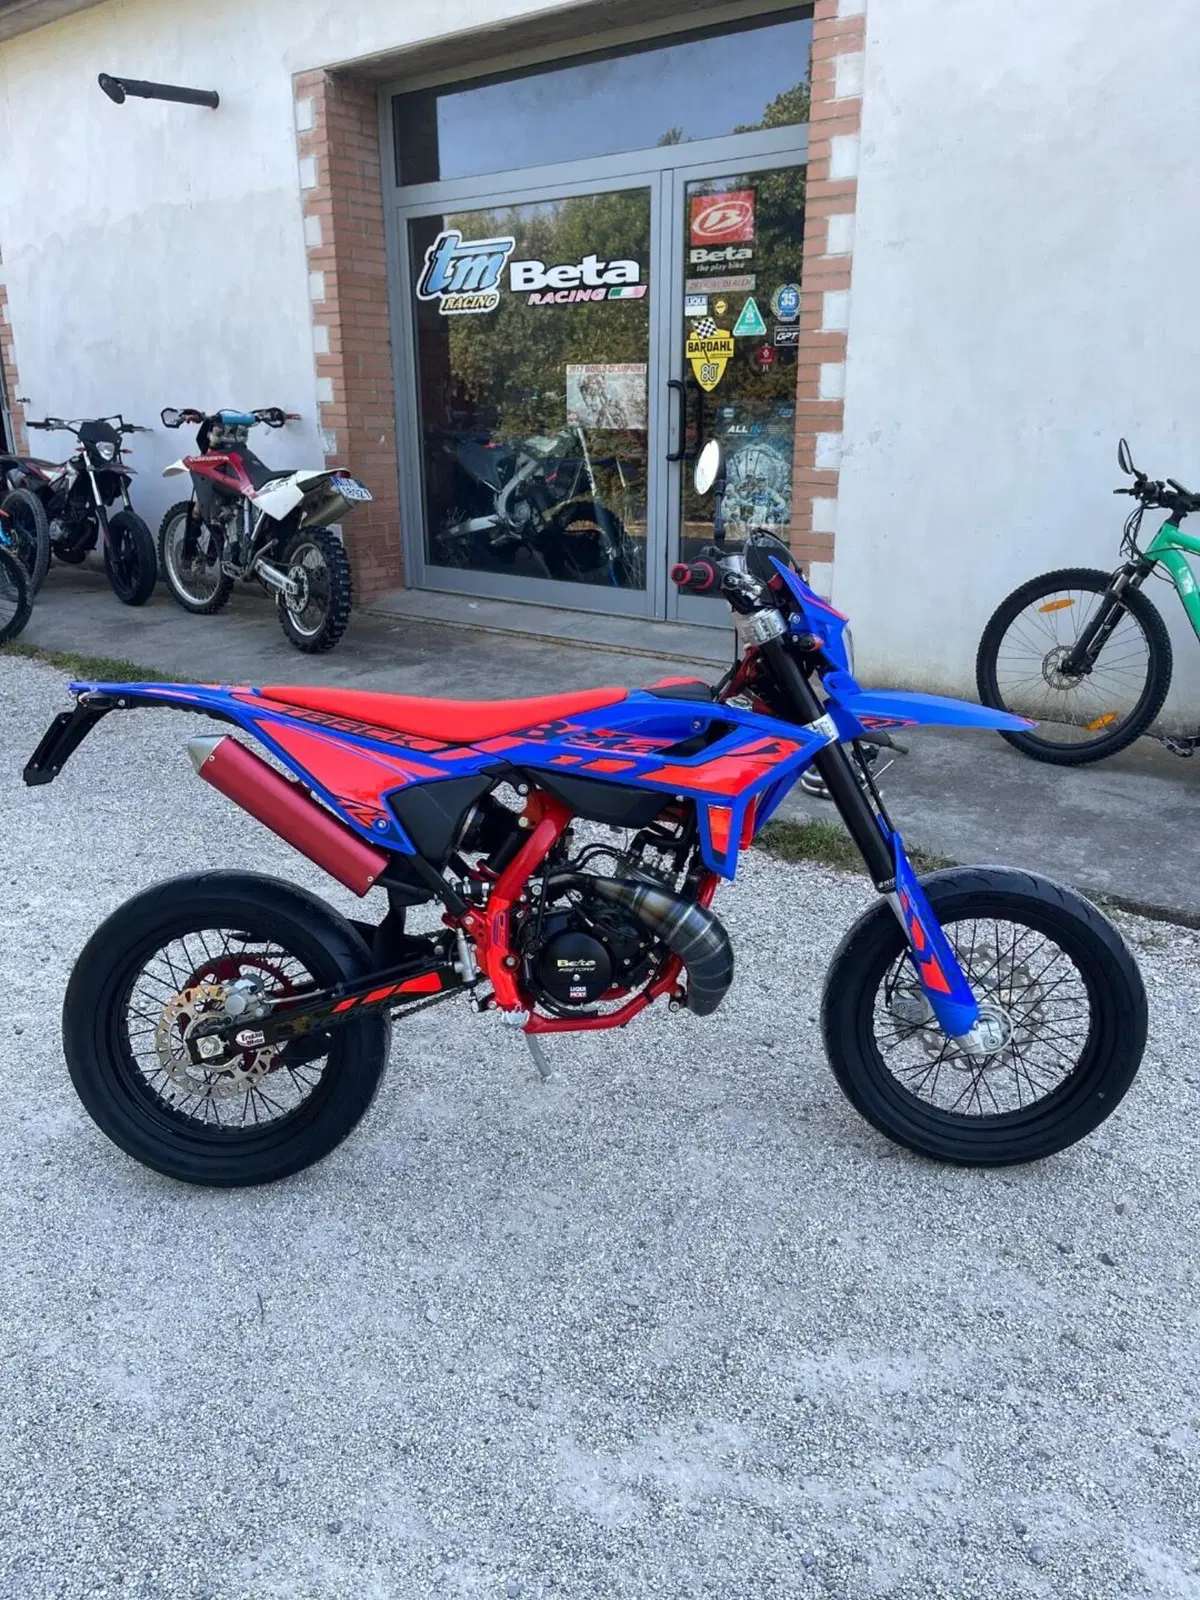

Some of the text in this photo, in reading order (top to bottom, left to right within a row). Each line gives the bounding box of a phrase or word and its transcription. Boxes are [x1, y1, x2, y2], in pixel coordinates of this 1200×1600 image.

[690, 246, 752, 264] Beta
[426, 235, 513, 293] tm
[696, 261, 745, 272] the play bike
[510, 255, 639, 291] Beta
[445, 293, 497, 311] RACING
[528, 288, 607, 305] RACING
[781, 293, 797, 306] 35
[777, 332, 799, 341] GPT
[688, 341, 732, 353] BARDAHL
[727, 424, 748, 433] ALL
[557, 959, 597, 967] Beta
